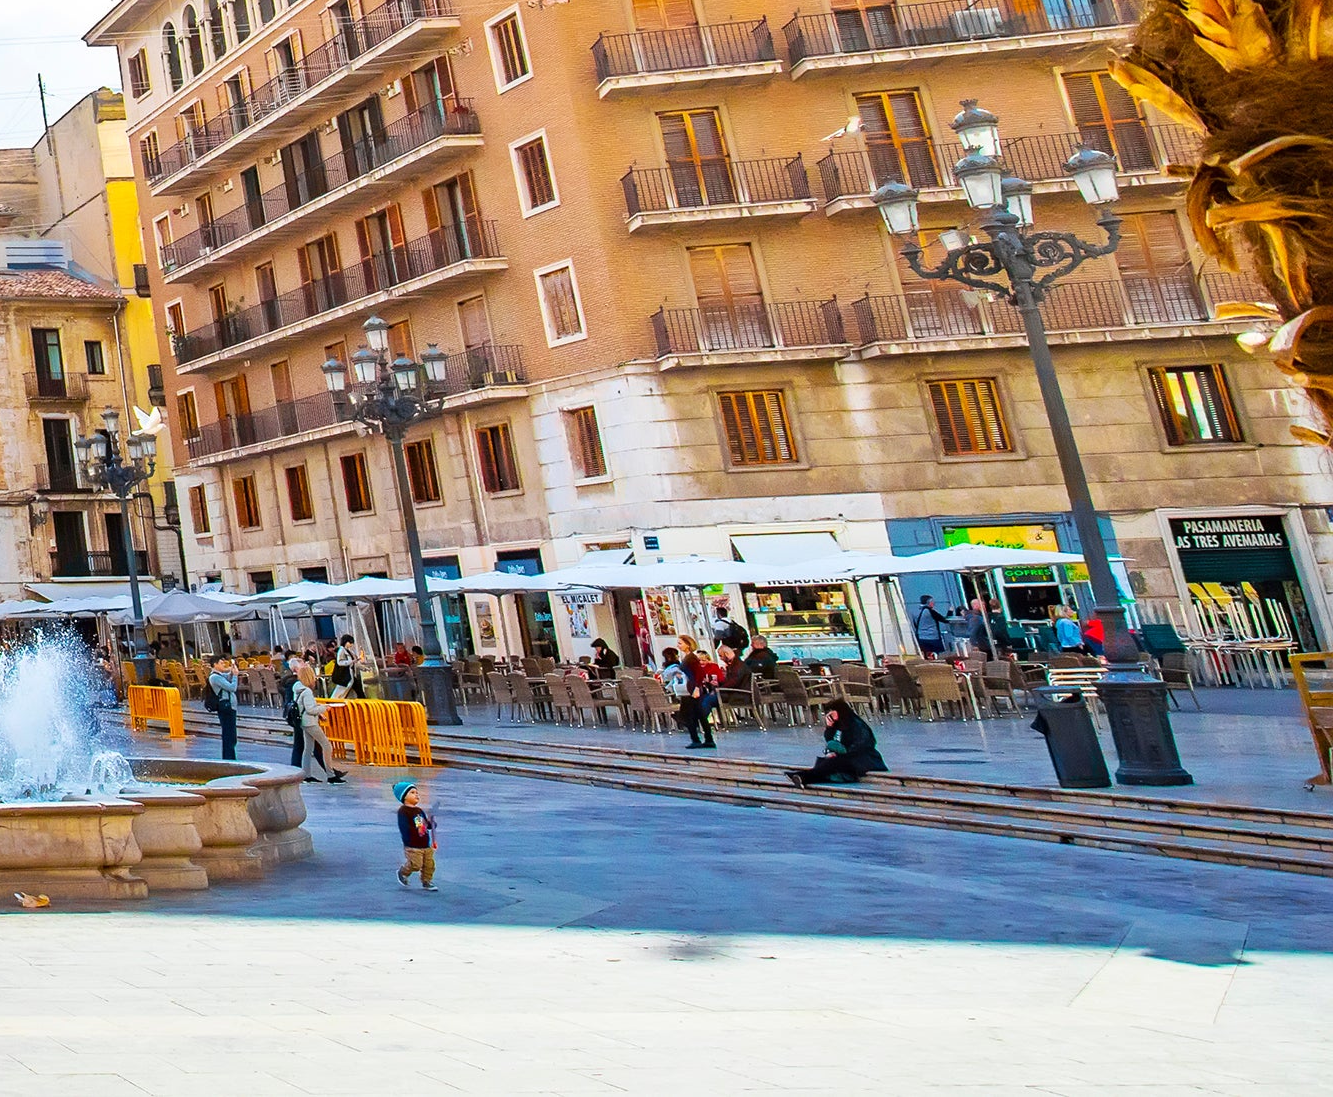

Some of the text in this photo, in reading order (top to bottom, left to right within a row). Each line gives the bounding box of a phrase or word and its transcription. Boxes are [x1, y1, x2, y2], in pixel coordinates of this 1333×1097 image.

[1183, 519, 1264, 533] PASAMANERIA
[1193, 535, 1219, 548] TRES
[1223, 533, 1282, 548] AVEMARIAS
[1004, 569, 1051, 577] GOFRES
[561, 594, 599, 604] EL MICALET
